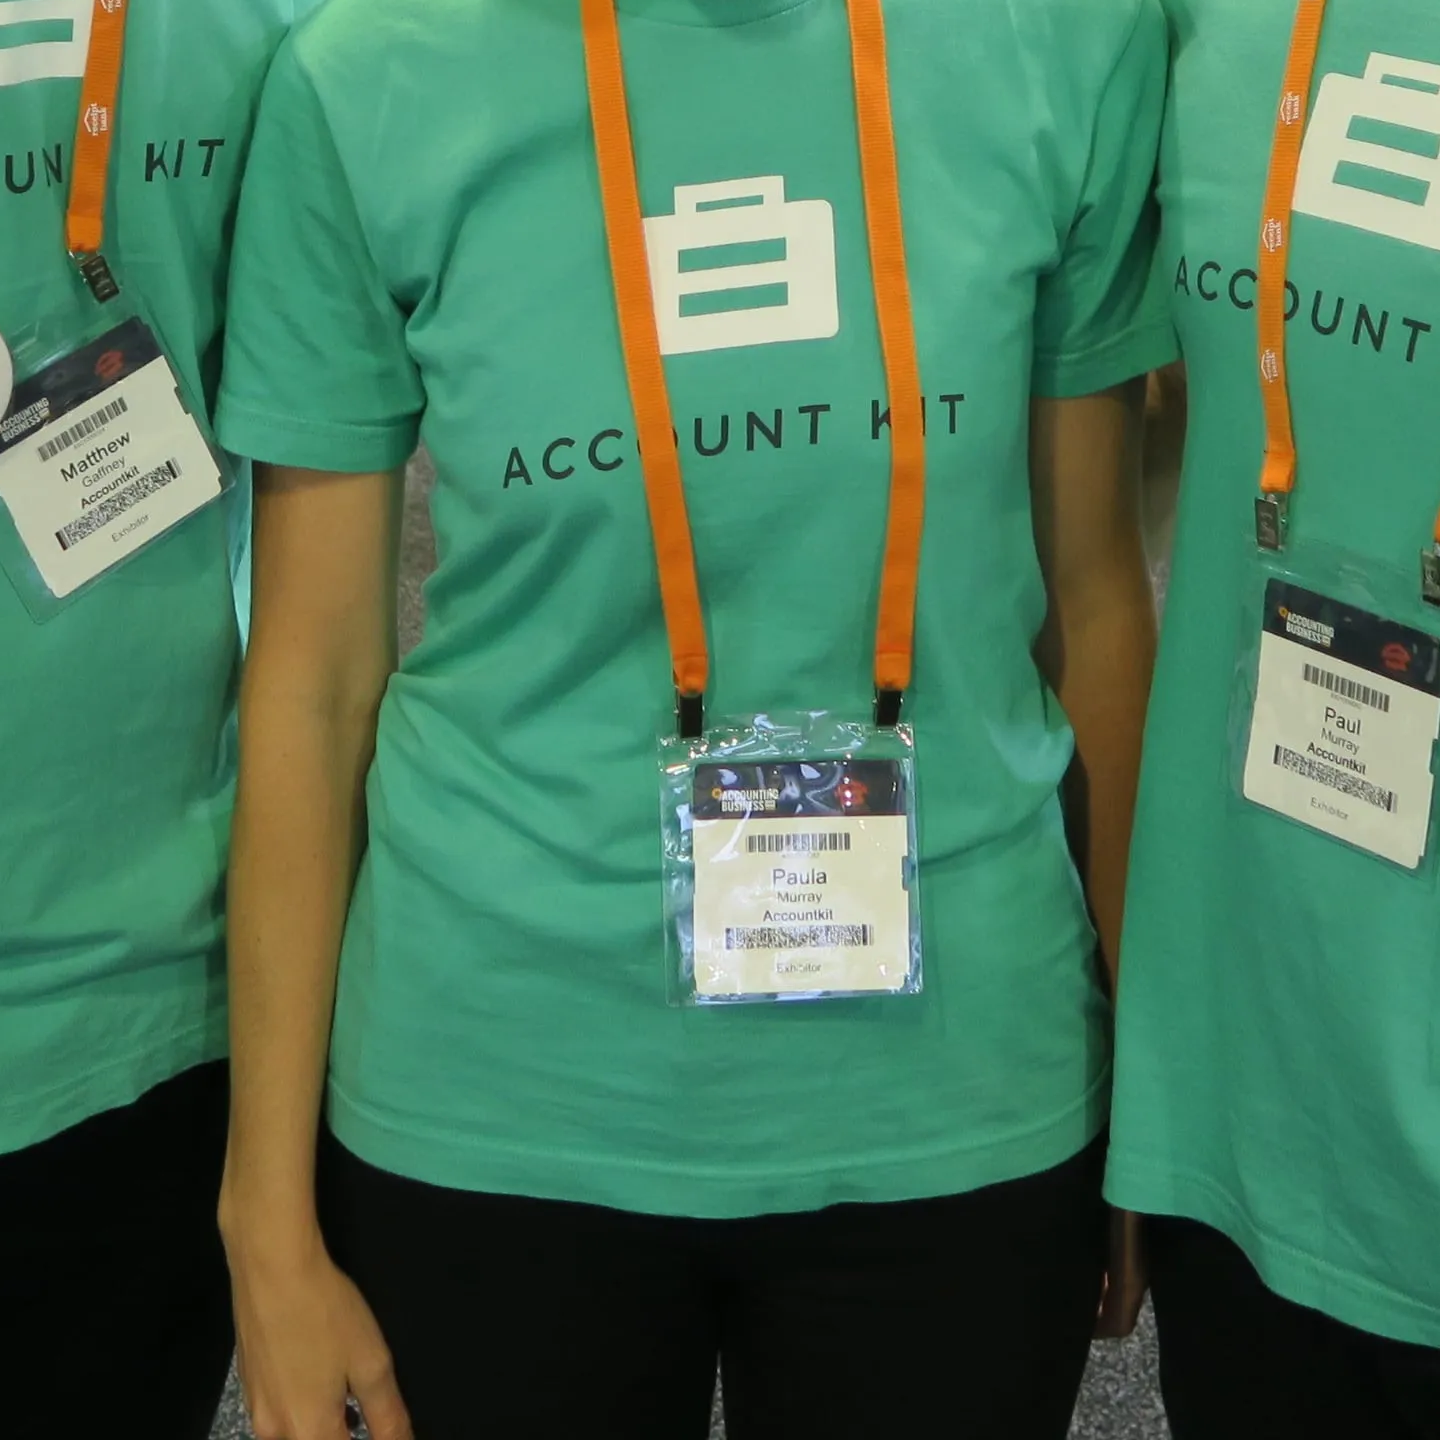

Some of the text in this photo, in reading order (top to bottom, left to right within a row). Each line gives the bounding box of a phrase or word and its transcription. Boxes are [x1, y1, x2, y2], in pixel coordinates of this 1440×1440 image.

[144, 138, 226, 182] KIT
[1, 416, 41, 443] BUSINESS
[60, 431, 132, 483] Matthew
[81, 455, 127, 488] Gaffney
[80, 464, 141, 510] Accountkit
[111, 513, 150, 543] Exhibitor
[1286, 622, 1321, 643] BUSINESS
[1287, 611, 1335, 638] ACCOUNTING
[1324, 706, 1362, 736] Paul
[1320, 727, 1360, 756] Murray
[1307, 742, 1367, 775] Accountkit
[721, 788, 779, 801] ACCOUNTING
[721, 800, 764, 812] BUSINESS
[1310, 796, 1349, 821] Exhibitor
[772, 868, 828, 885] Paula
[777, 891, 823, 904] Murray
[762, 908, 834, 922] Accountkit
[776, 962, 822, 974] Exhibitor
